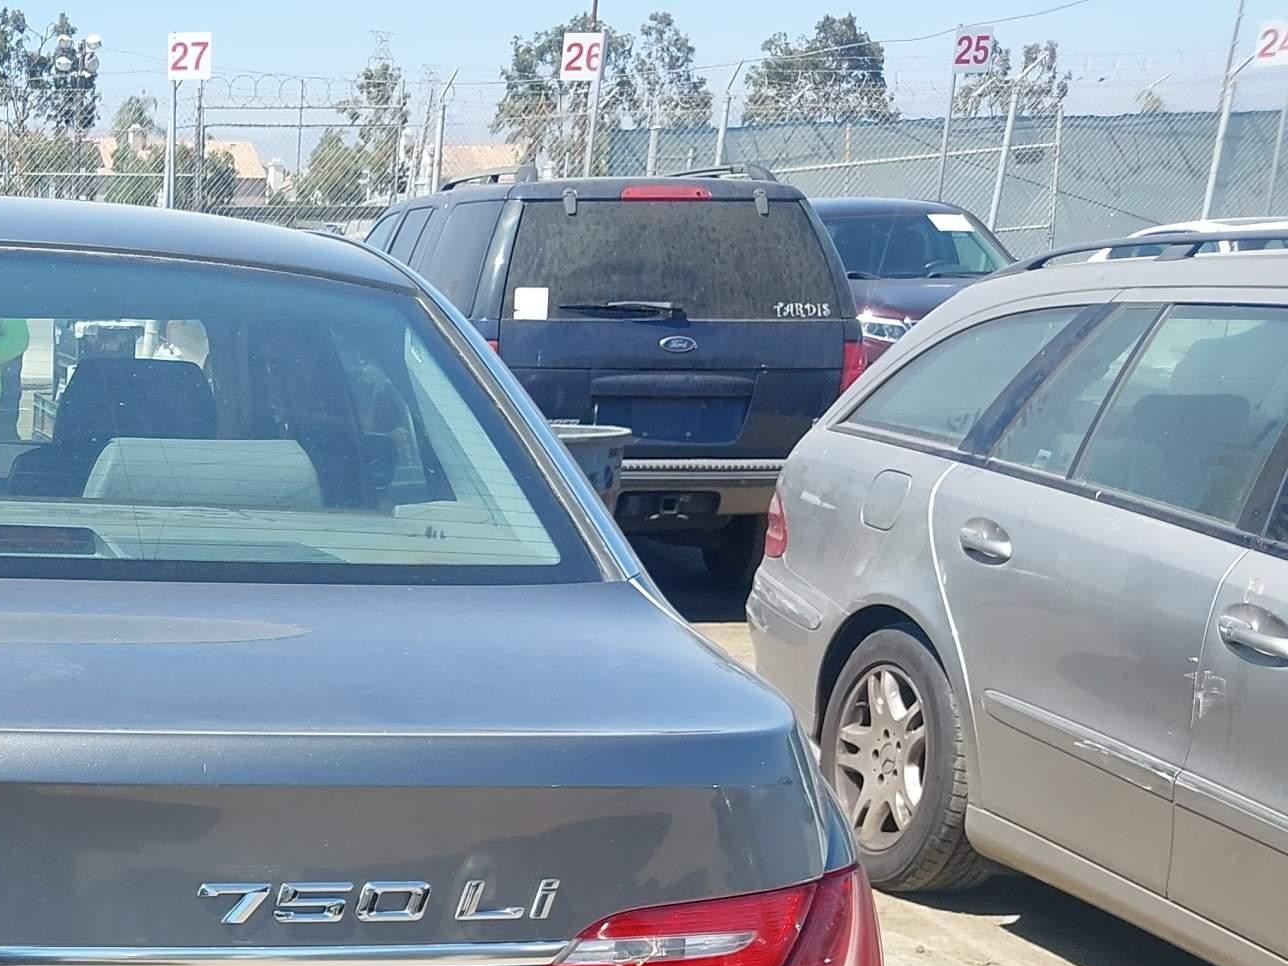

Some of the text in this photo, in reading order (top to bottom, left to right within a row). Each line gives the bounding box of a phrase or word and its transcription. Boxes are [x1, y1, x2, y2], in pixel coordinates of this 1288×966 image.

[170, 41, 210, 71] 27
[565, 42, 601, 72] 26
[954, 35, 992, 65] 25
[773, 301, 831, 318] TARDIS
[197, 878, 561, 924] 750 Li
